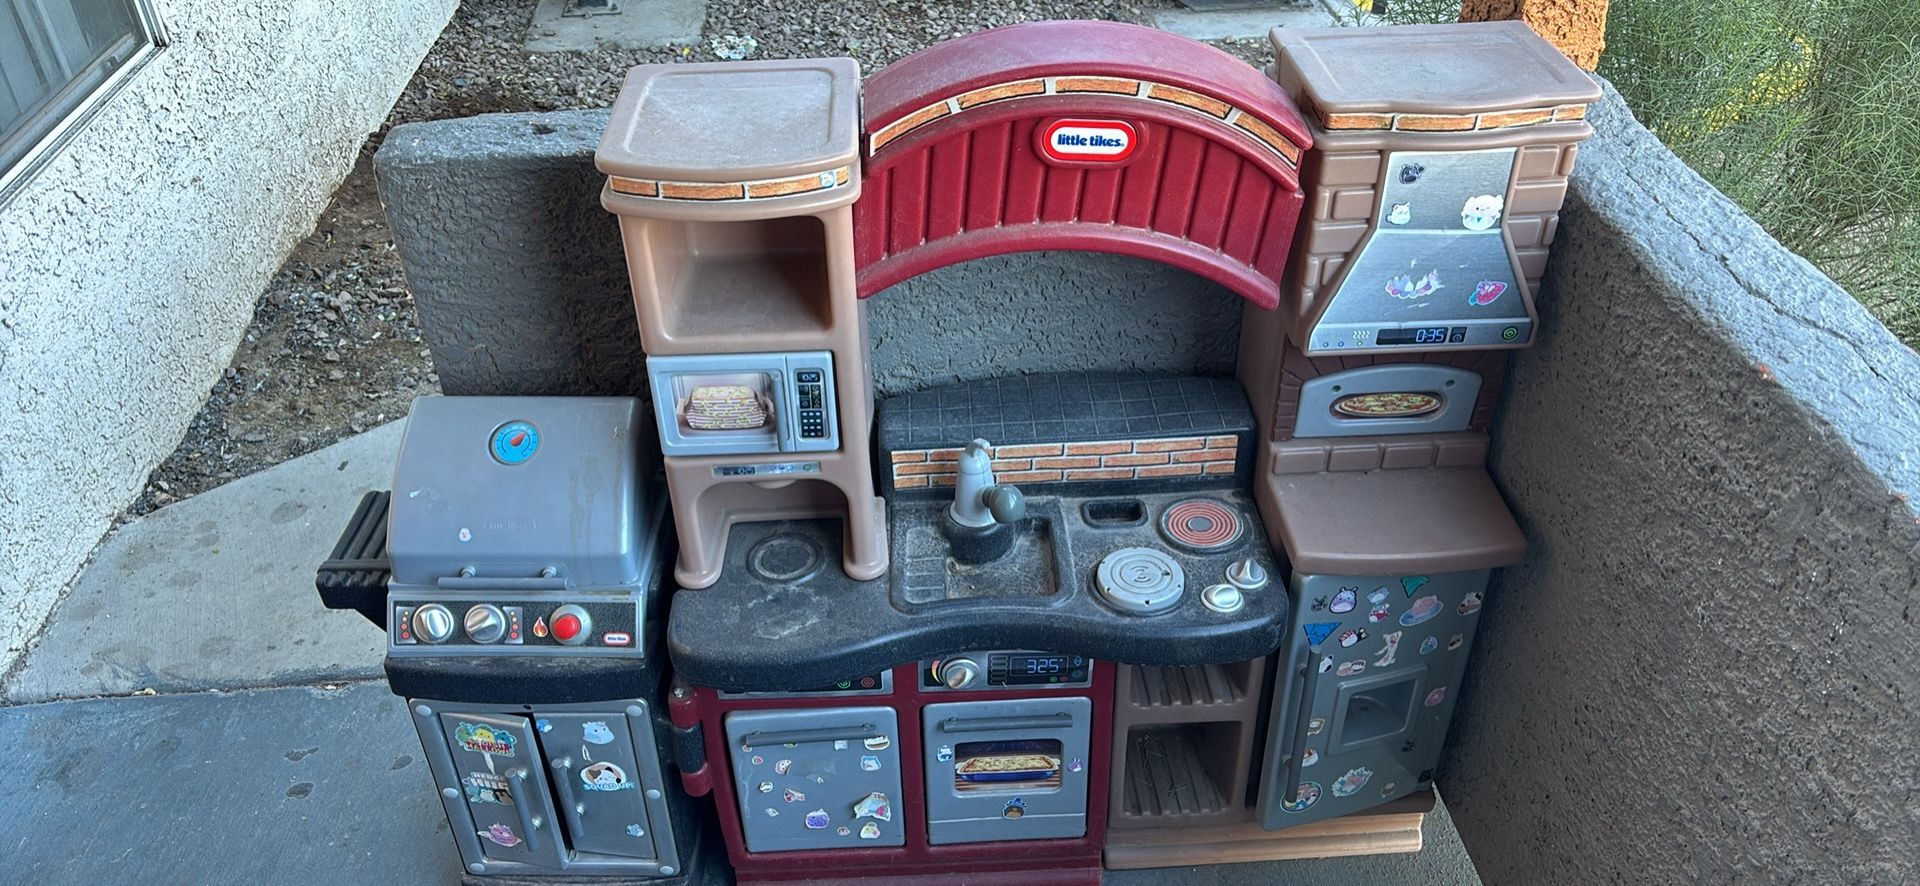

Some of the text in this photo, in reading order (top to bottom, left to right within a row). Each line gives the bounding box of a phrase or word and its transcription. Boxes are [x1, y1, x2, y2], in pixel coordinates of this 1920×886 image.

[1057, 134, 1087, 146] little
[1415, 329, 1445, 342] 0:35
[583, 783, 618, 791] SQUAD
